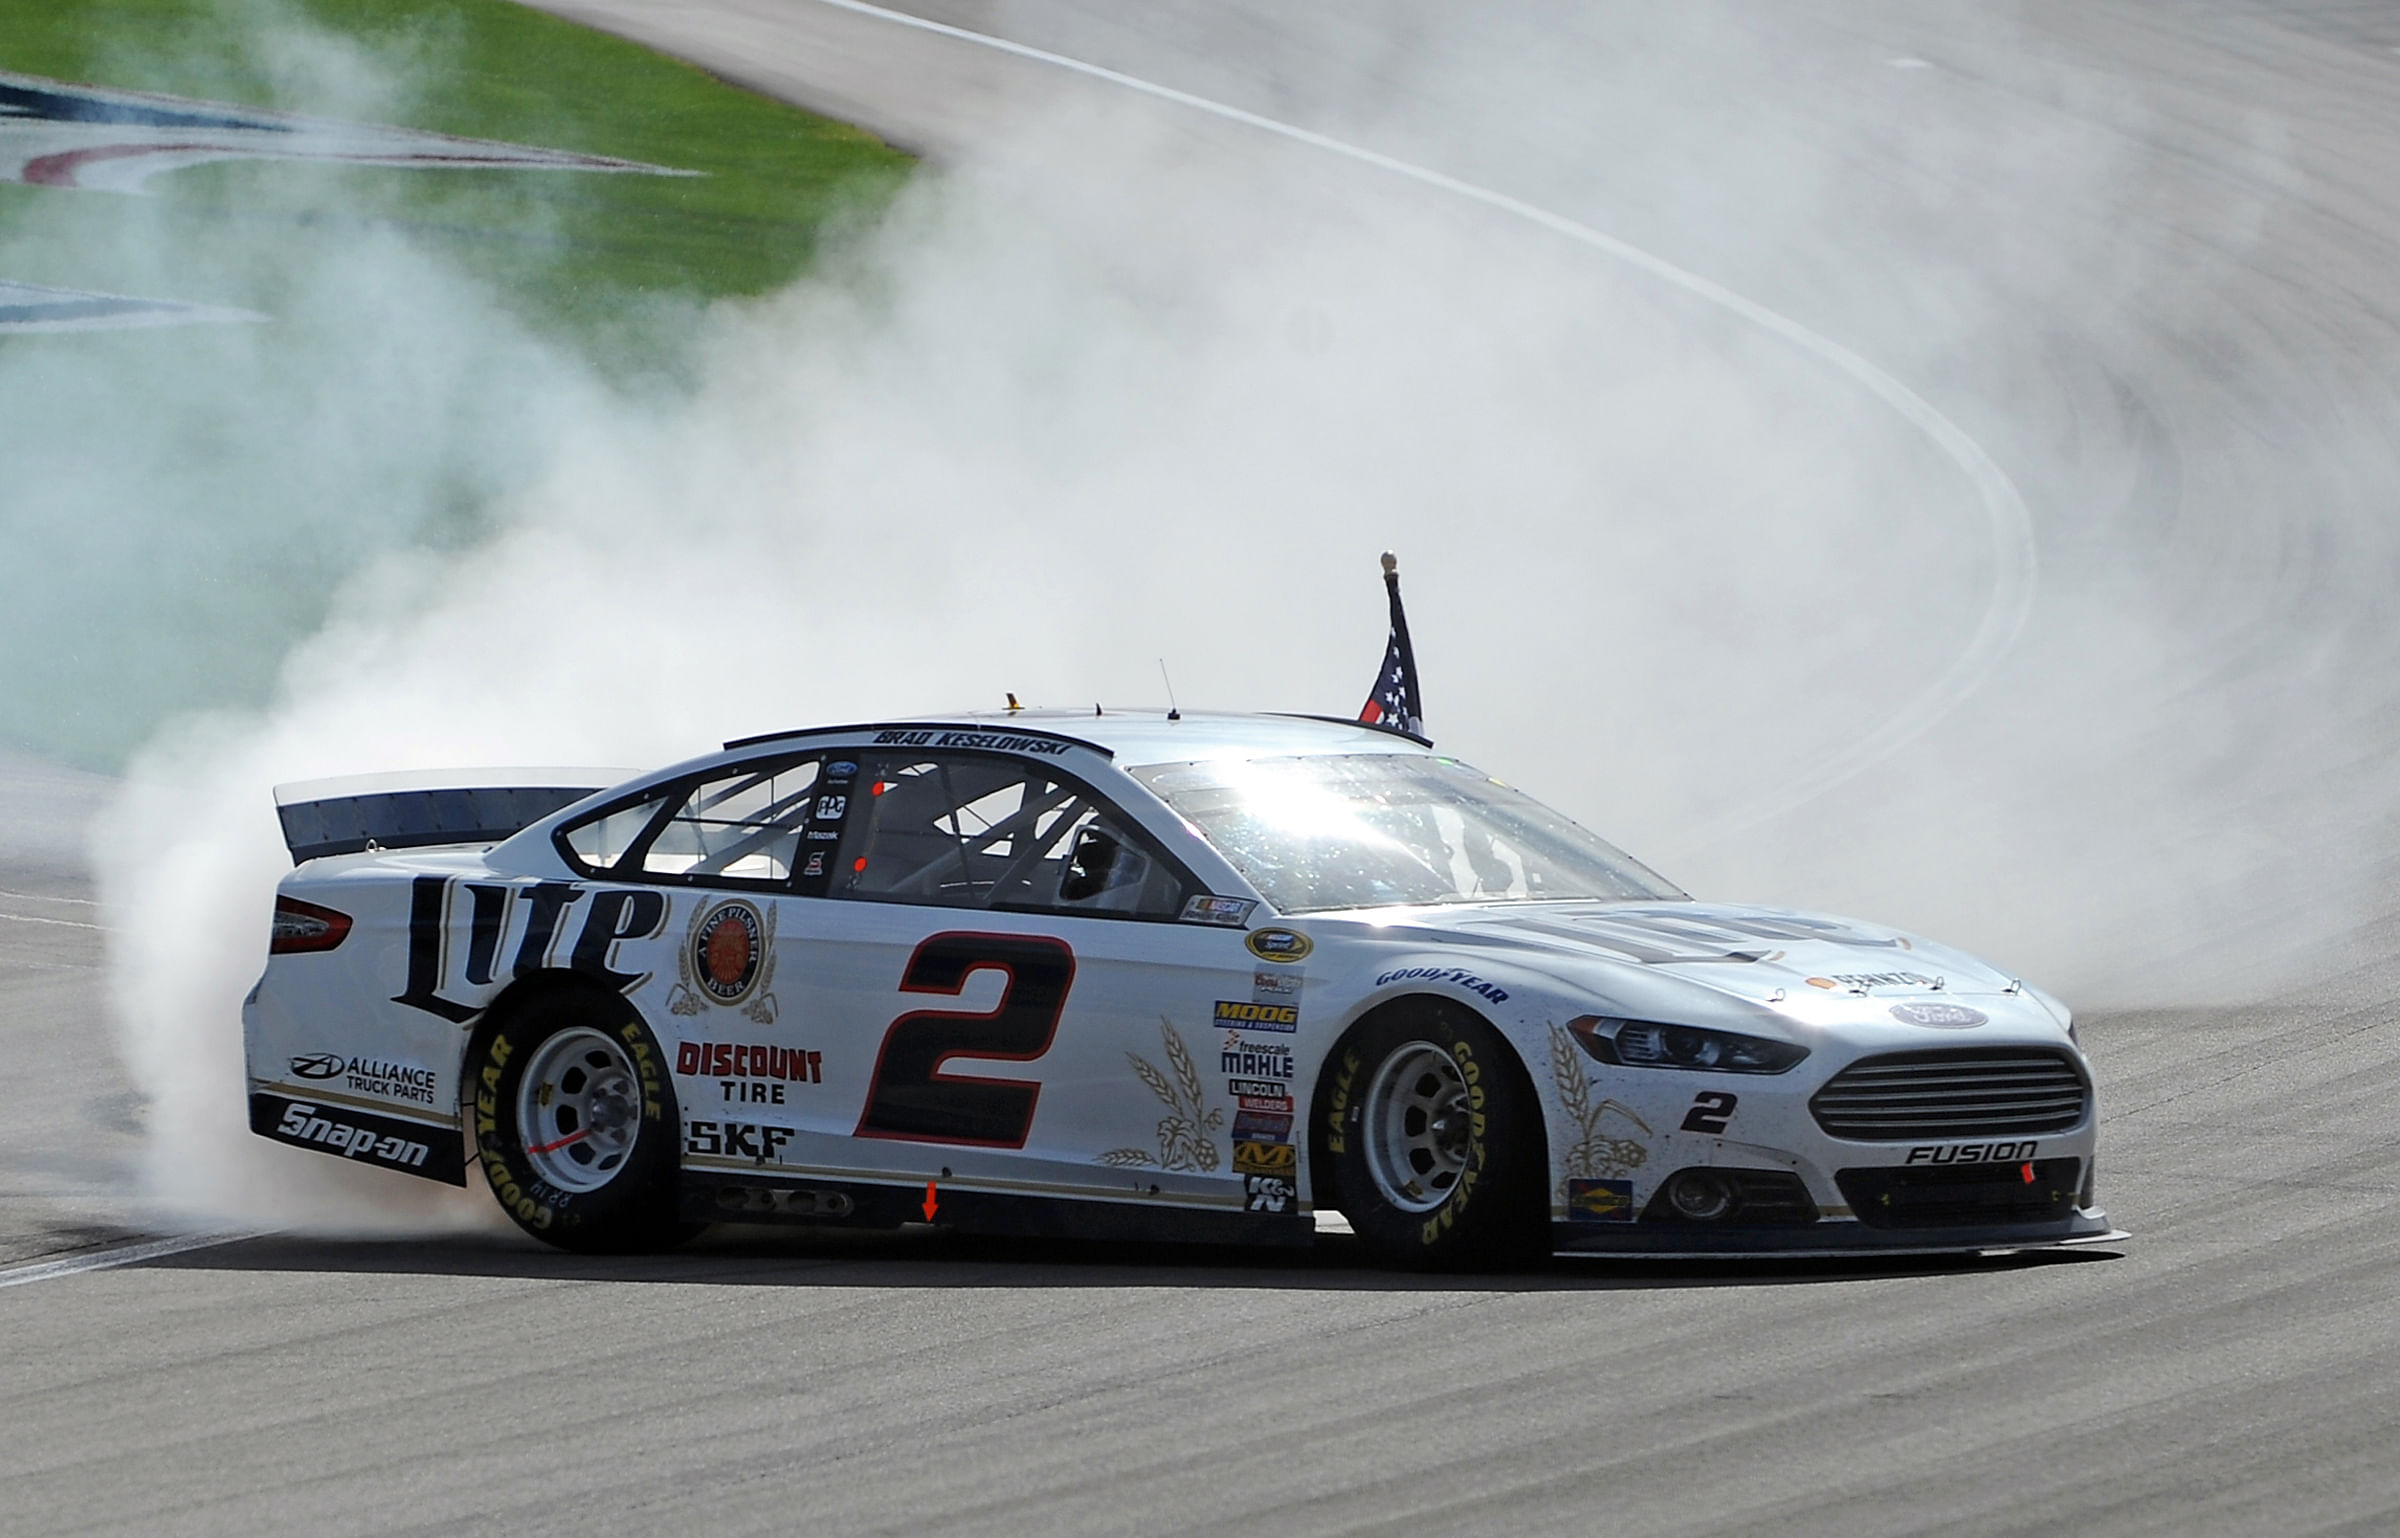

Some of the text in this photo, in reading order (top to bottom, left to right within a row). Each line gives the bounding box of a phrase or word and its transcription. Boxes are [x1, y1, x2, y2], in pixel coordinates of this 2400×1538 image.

[873, 731, 1074, 755] BRAD KESELOWSKI
[818, 795, 845, 816] PPG
[698, 907, 759, 963] A FINE PILSNER
[707, 977, 745, 996] BEER
[1375, 966, 1509, 1005] GOODYEAR
[1215, 1002, 1297, 1023] MOOG
[852, 930, 1077, 1150] 2
[1239, 1040, 1290, 1056] freescale
[346, 1057, 436, 1089] ALLIANCE
[620, 1022, 661, 1121] EAGLE
[676, 1041, 822, 1084] DISCOUNT
[1221, 1052, 1294, 1078] MAHLE
[346, 1075, 435, 1104] TRUCK PARTS
[720, 1080, 785, 1105] TIRE
[1231, 1081, 1284, 1097] LINCOLN
[1328, 1051, 1360, 1153] EAGLE
[1243, 1098, 1288, 1111] WELDERS
[1679, 1090, 1738, 1135] 2
[277, 1102, 430, 1167] Snap-on
[688, 1121, 796, 1158] SKF
[1905, 1140, 2039, 1166] FUSION
